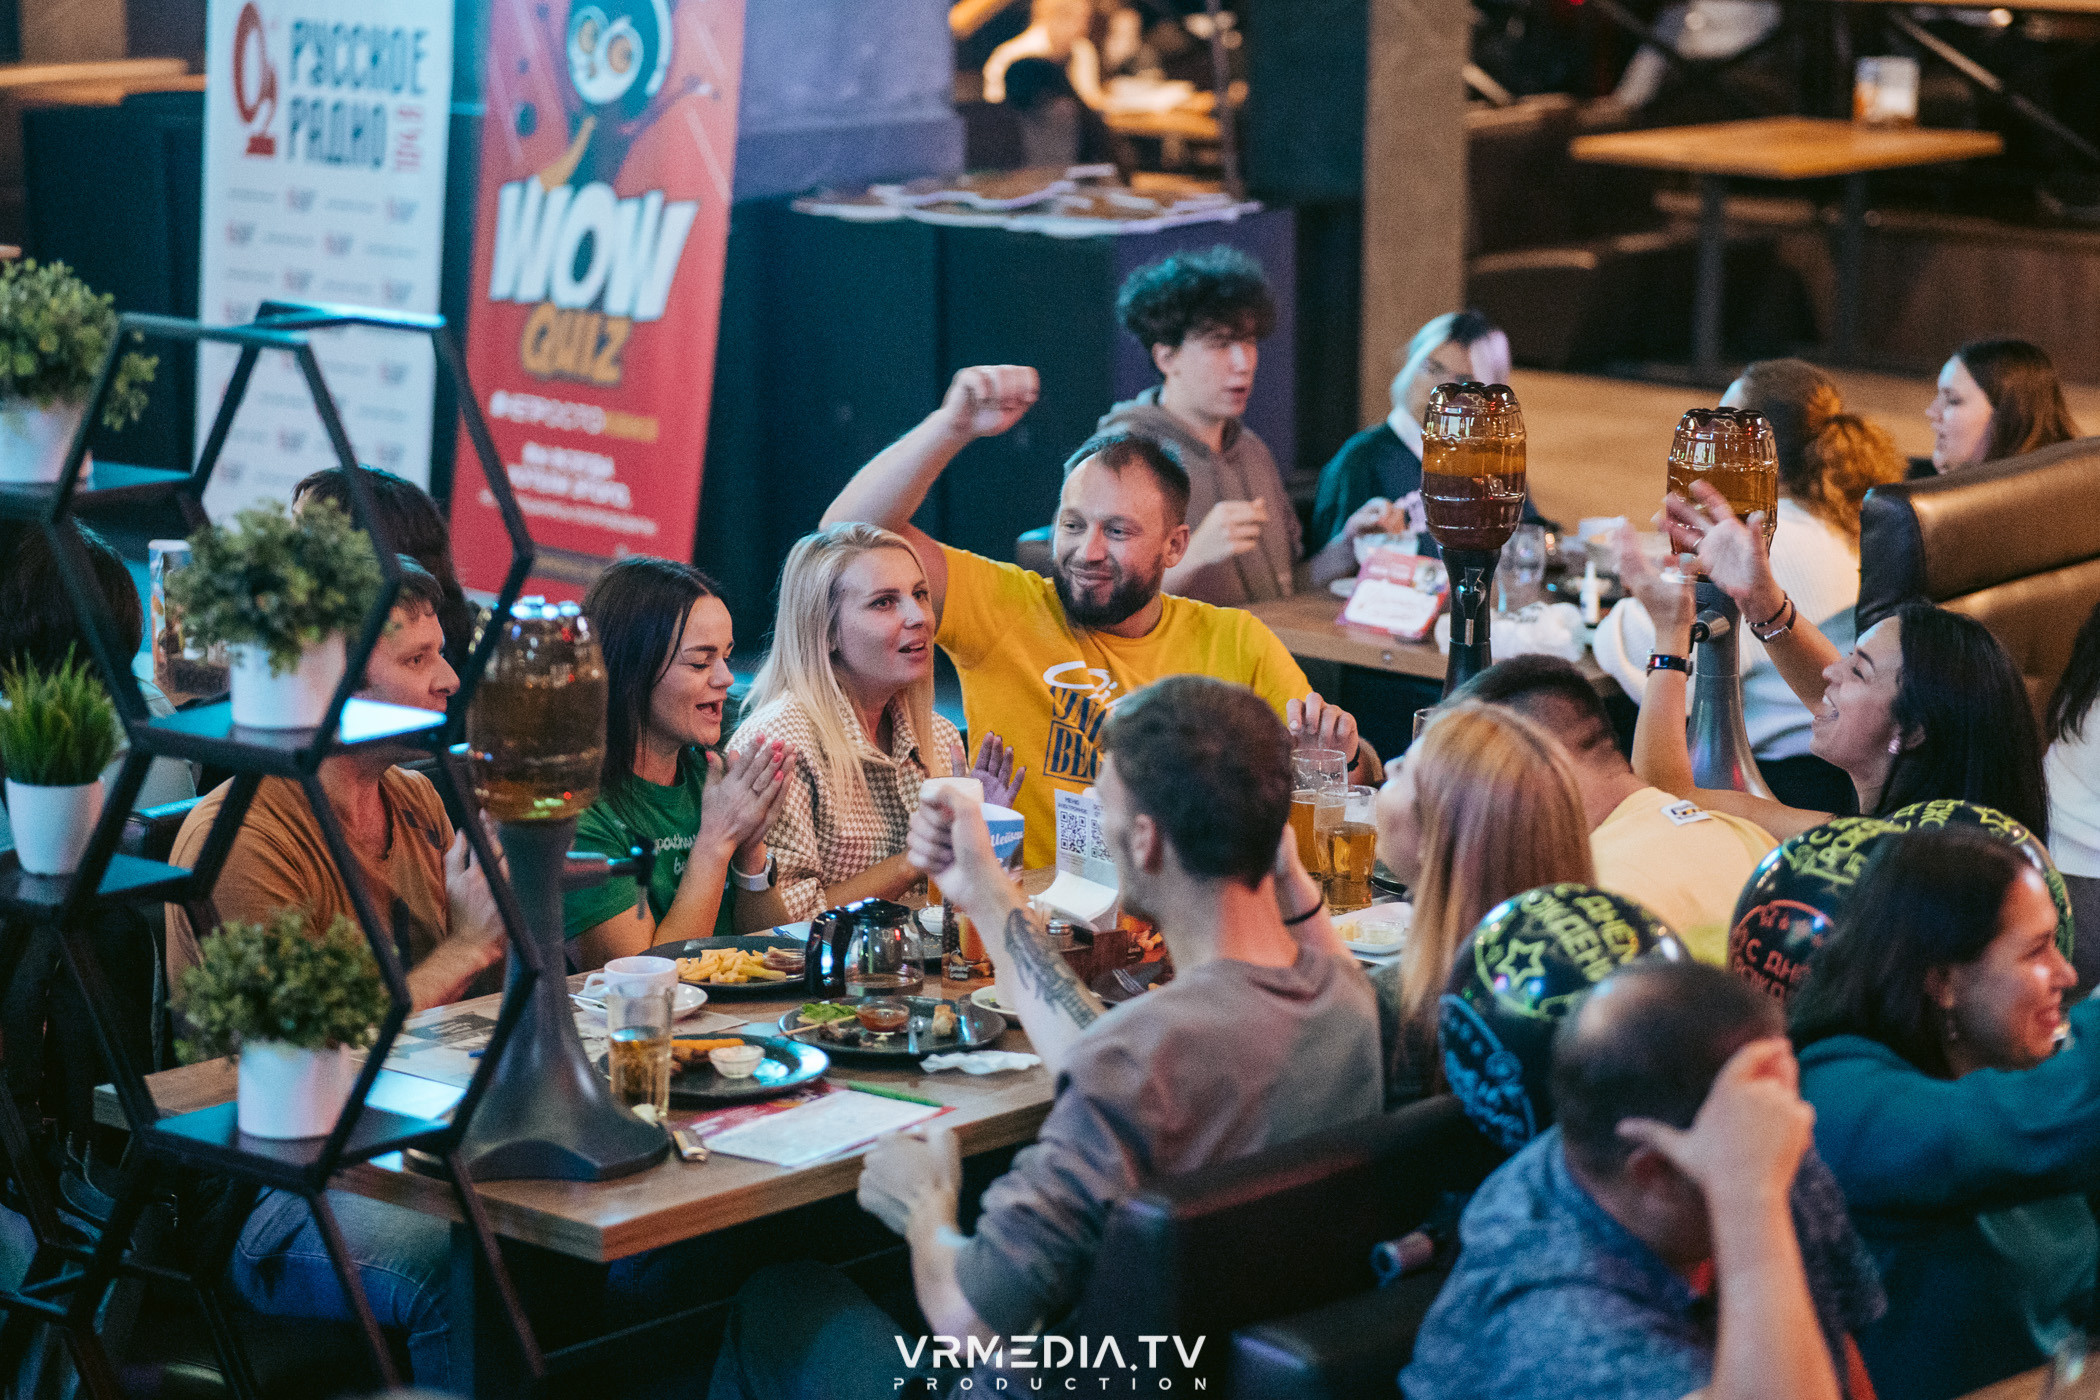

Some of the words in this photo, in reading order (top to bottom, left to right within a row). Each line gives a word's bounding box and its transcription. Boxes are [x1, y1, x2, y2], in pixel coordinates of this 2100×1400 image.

[290, 18, 427, 95] РУССКОЕ
[286, 96, 388, 172] РАДИО
[490, 174, 699, 322] WOW
[521, 302, 632, 382] QUIZ
